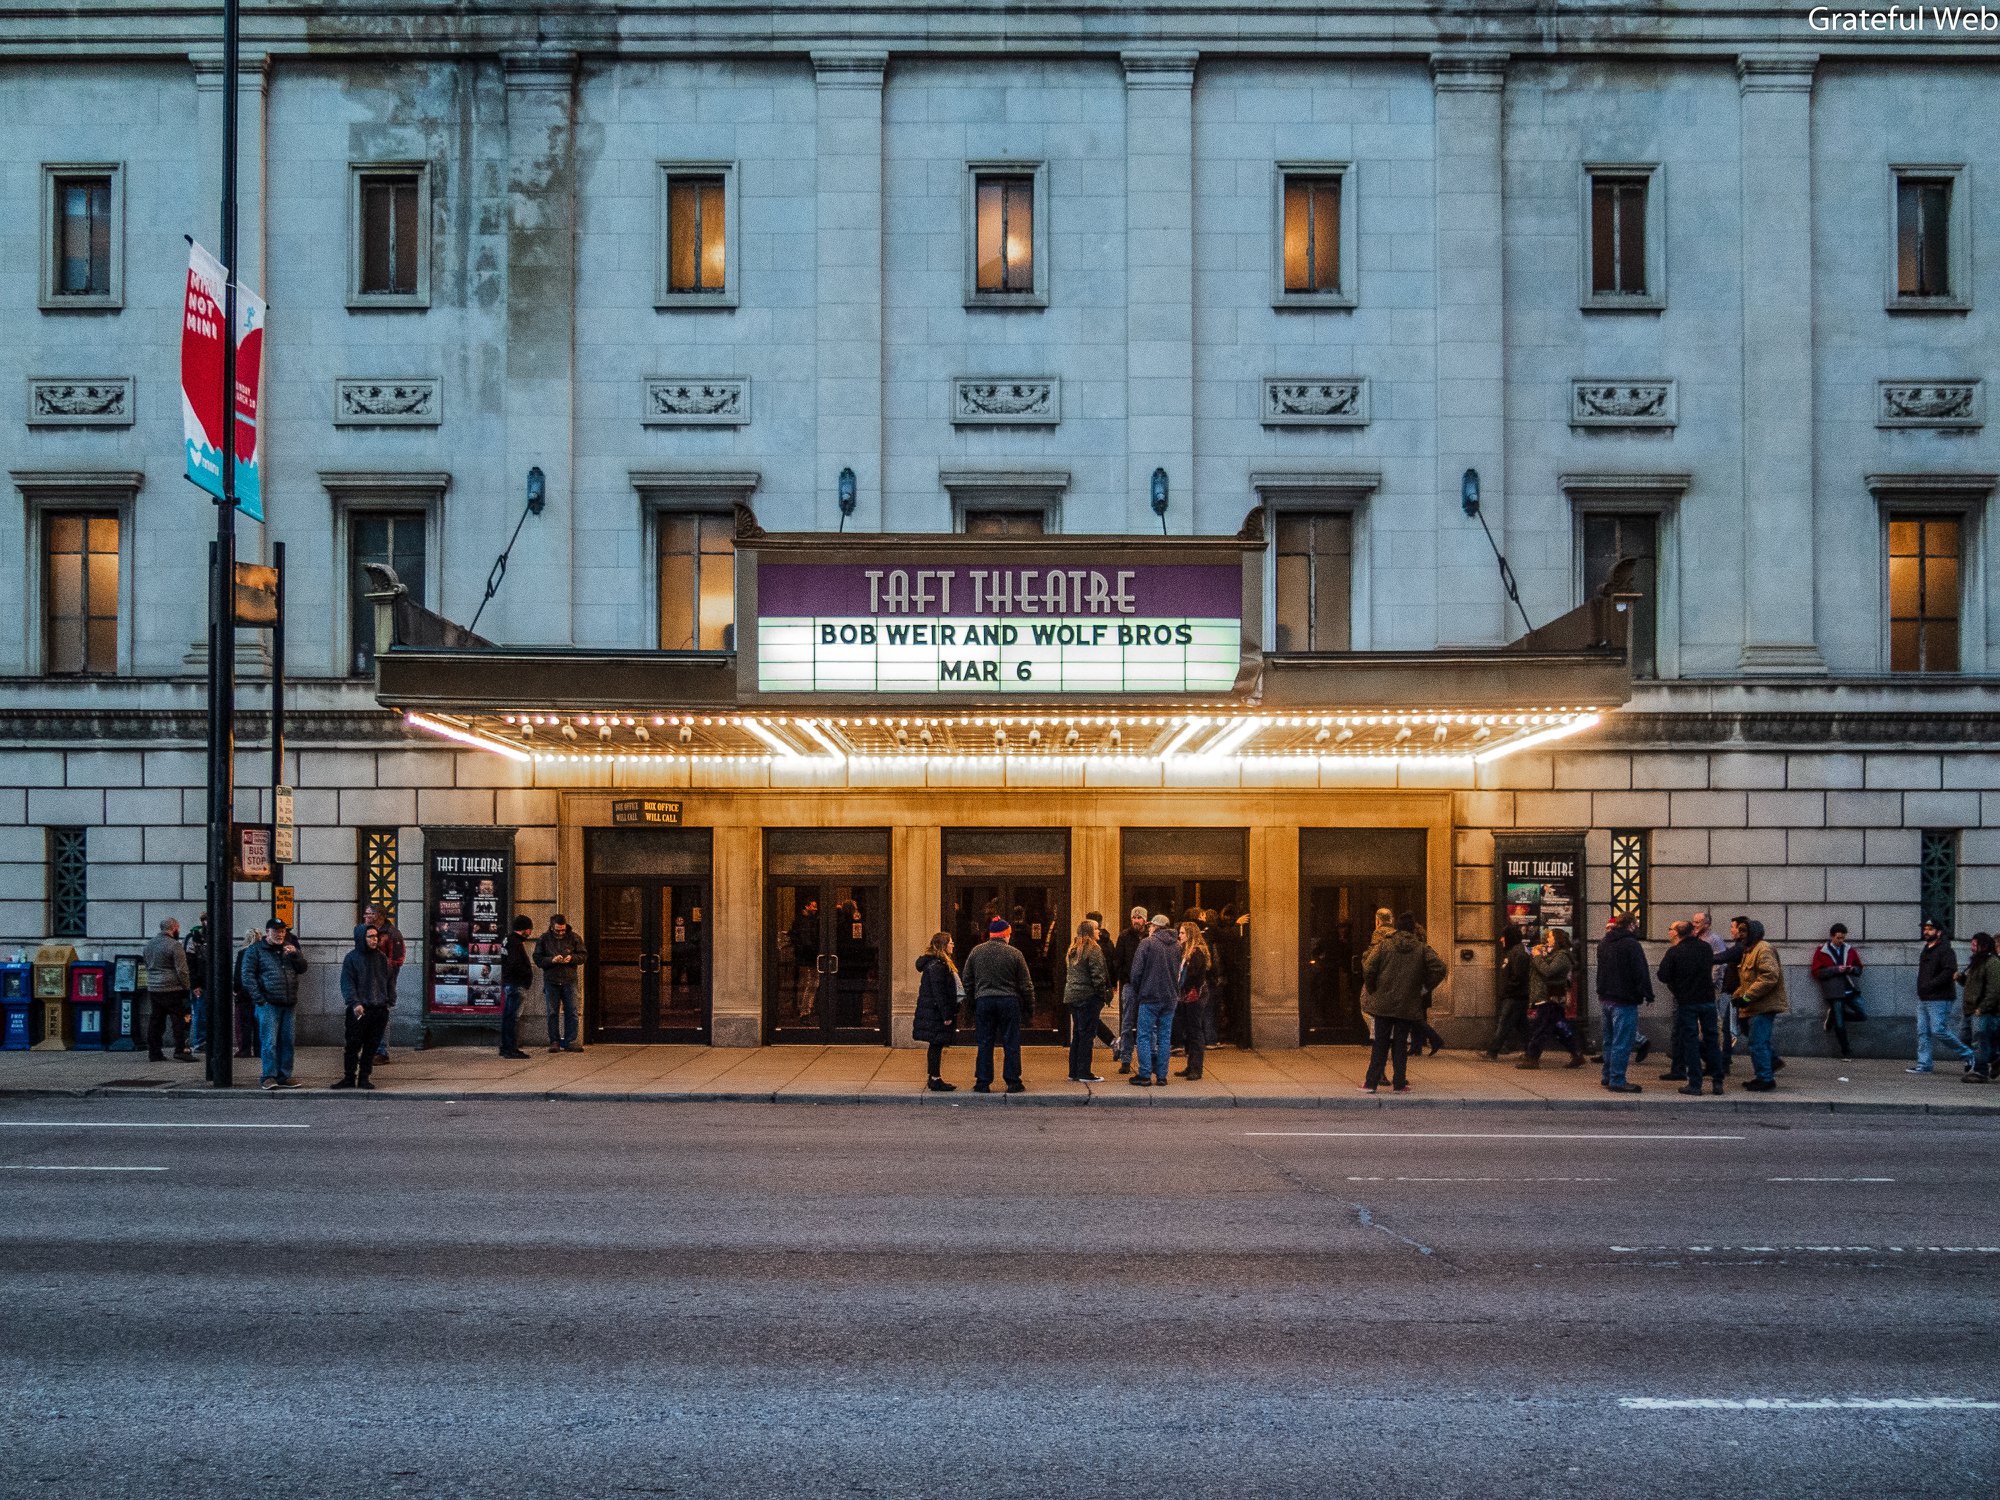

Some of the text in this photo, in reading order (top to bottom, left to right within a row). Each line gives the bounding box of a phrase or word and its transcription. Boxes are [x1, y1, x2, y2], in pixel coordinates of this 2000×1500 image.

[188, 292, 215, 319] NOT
[186, 312, 218, 341] MINI
[865, 569, 1136, 614] TAFT THEATRE
[821, 623, 1193, 646] BOB WEIR AND WOLF BROS
[939, 660, 1033, 682] MAR 6
[644, 801, 679, 812] BOX OFFICE
[645, 812, 678, 823] WILL CALL
[248, 846, 264, 856] BUS
[247, 856, 266, 866] STOP
[437, 856, 504, 873] TAFT THEATRE
[1507, 861, 1574, 877] TAFT THEATRE
